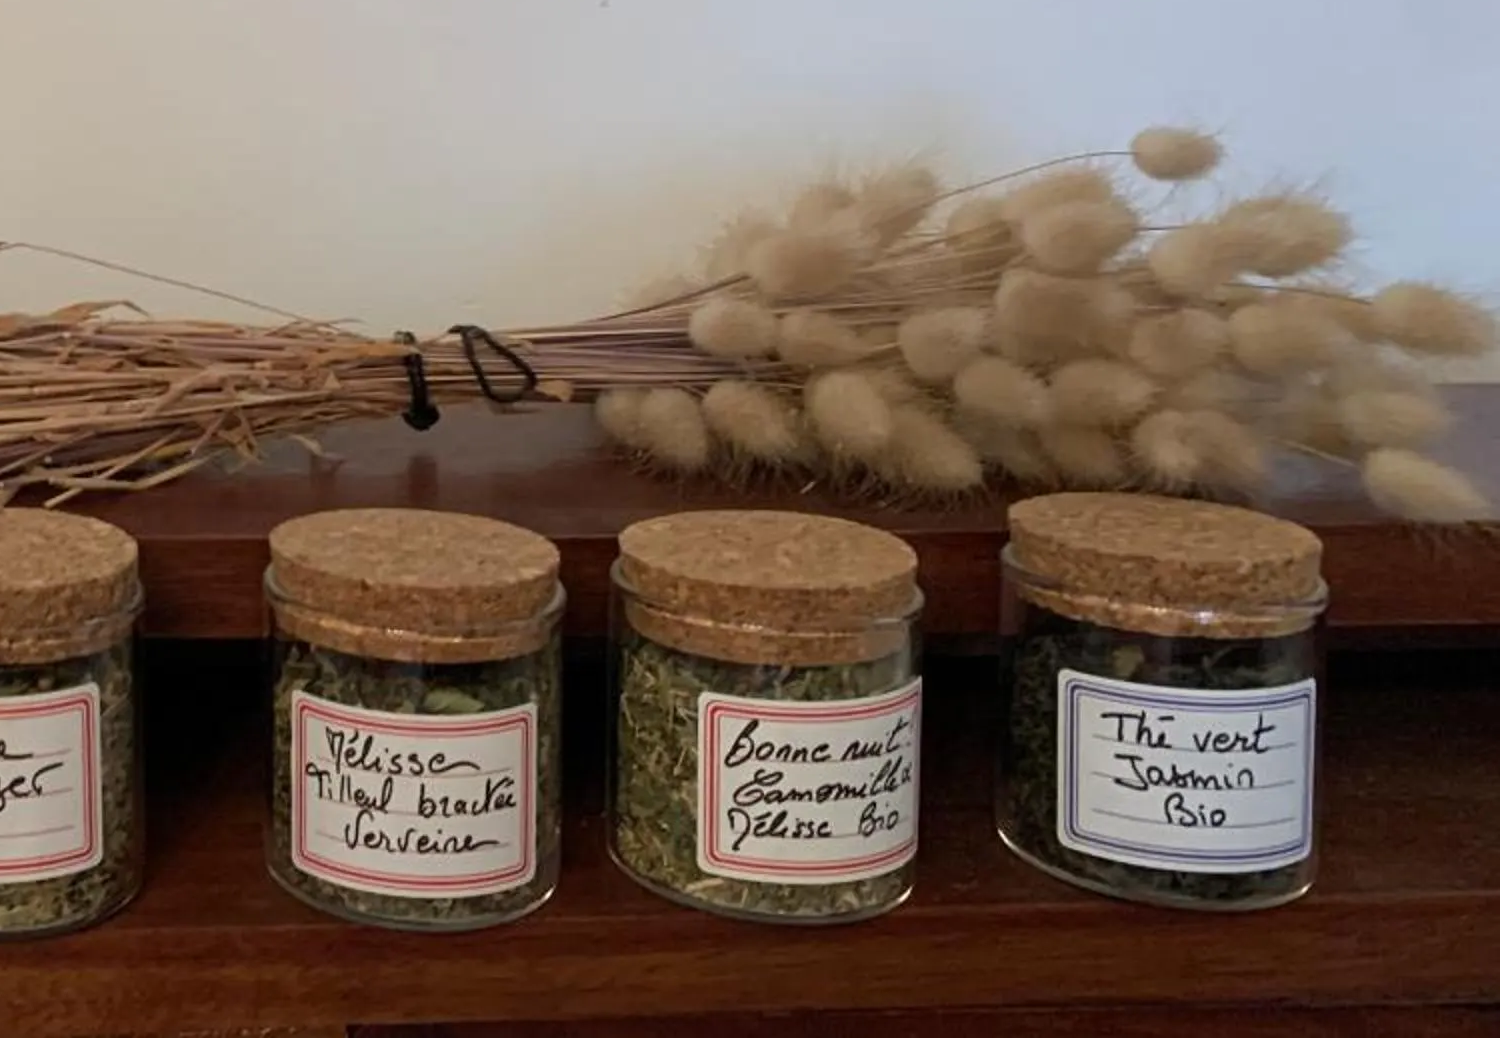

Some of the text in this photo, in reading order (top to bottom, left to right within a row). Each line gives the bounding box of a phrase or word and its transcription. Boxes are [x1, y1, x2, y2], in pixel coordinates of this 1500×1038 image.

[325, 725, 481, 775] Mélisse
[724, 719, 832, 767] Bonne
[1100, 710, 1276, 754] Thé vert
[1113, 753, 1254, 792] Jasmin
[727, 801, 899, 851] Mélisse Bio
[1164, 792, 1226, 827] Bio
[345, 810, 500, 854] Verveine
